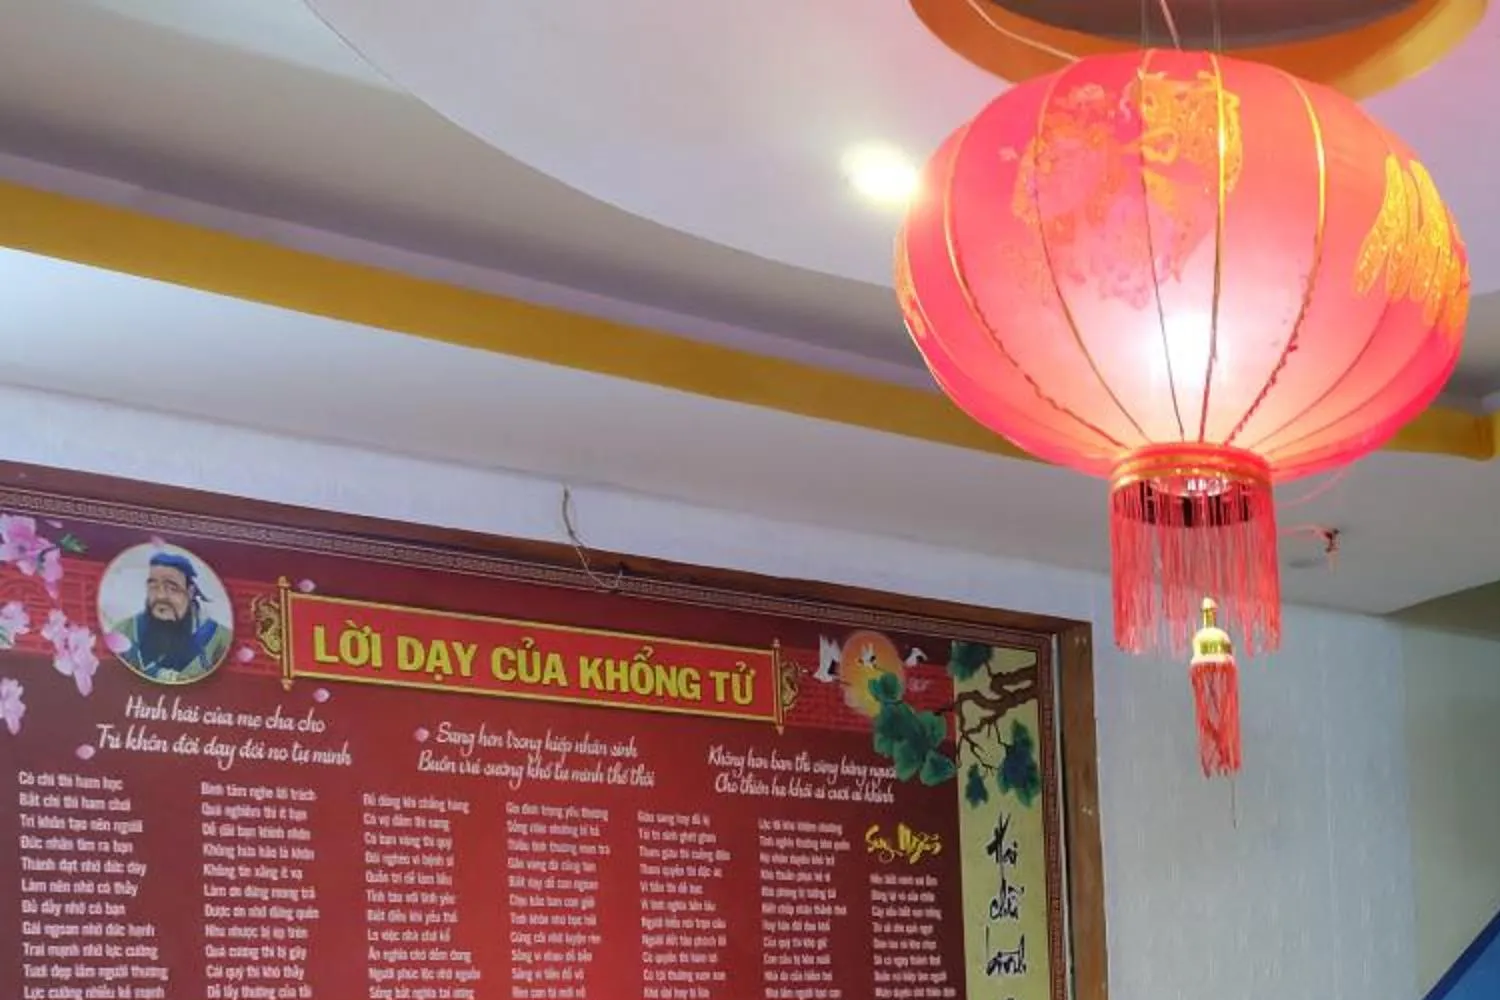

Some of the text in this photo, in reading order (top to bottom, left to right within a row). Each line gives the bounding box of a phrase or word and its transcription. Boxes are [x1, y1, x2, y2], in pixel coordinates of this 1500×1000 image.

[313, 619, 757, 706] LỜI DẠY CỦA KHỔNG TỬ
[265, 703, 293, 732] cha
[297, 707, 326, 733] cho
[268, 744, 289, 760] no
[435, 720, 475, 758] Sang
